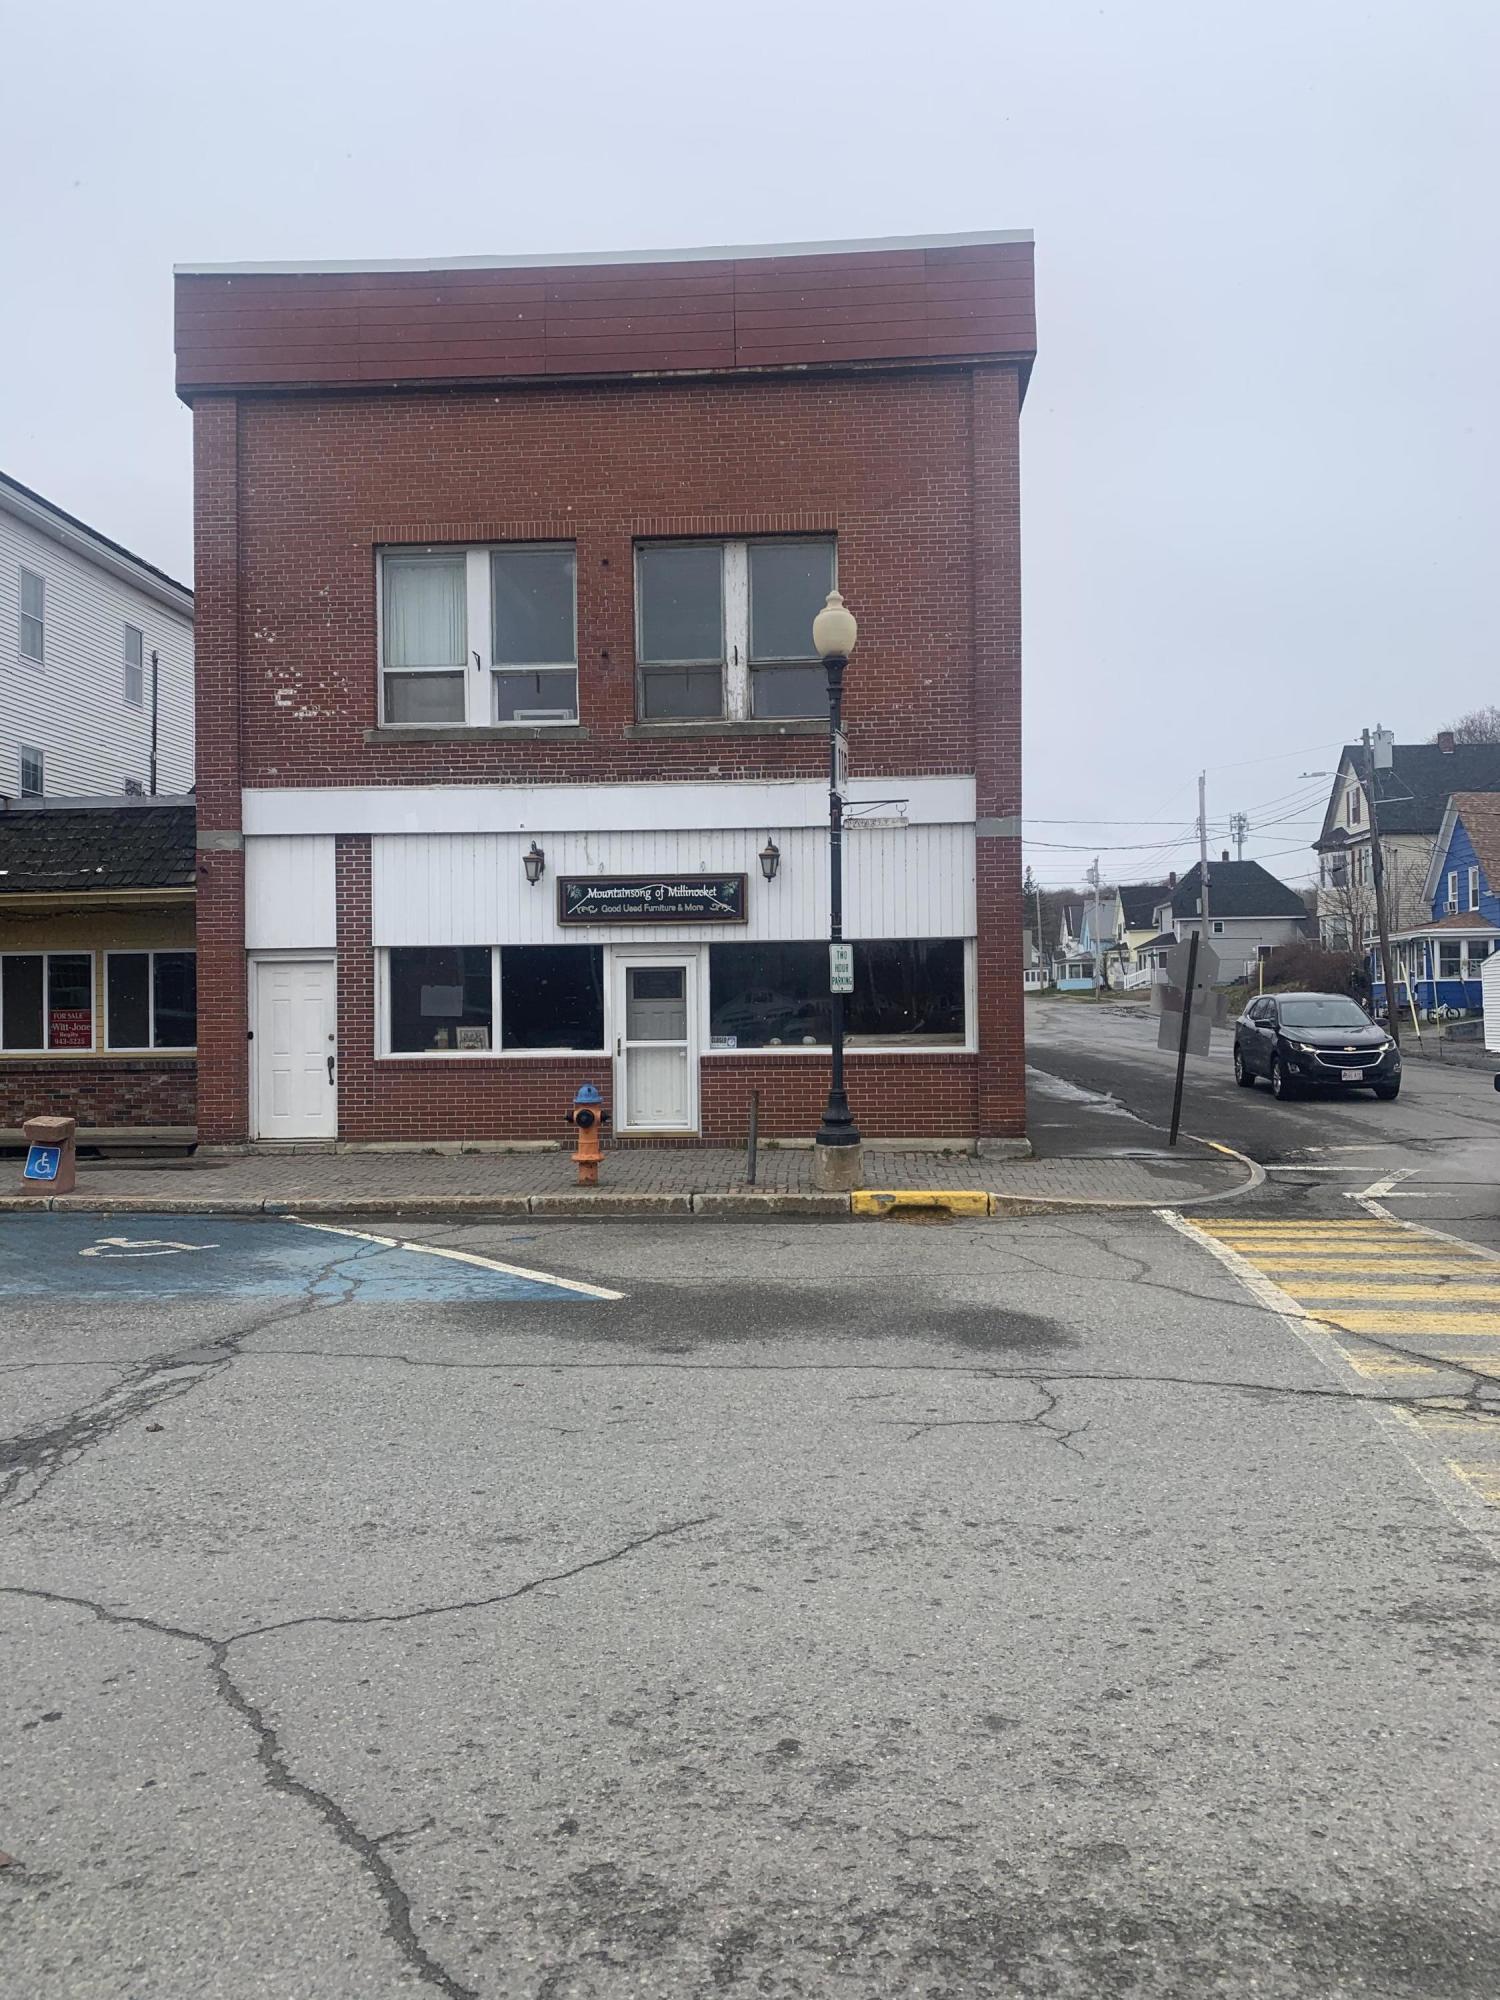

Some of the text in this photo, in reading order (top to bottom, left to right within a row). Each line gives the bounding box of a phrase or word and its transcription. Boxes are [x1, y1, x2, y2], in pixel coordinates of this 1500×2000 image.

[587, 885, 717, 901] Mountainsong of Millinocket
[601, 903, 704, 913] Good Used Furniture & More
[836, 951, 848, 960] TWO
[835, 964, 849, 973] HOUR
[832, 976, 853, 985] PARKING
